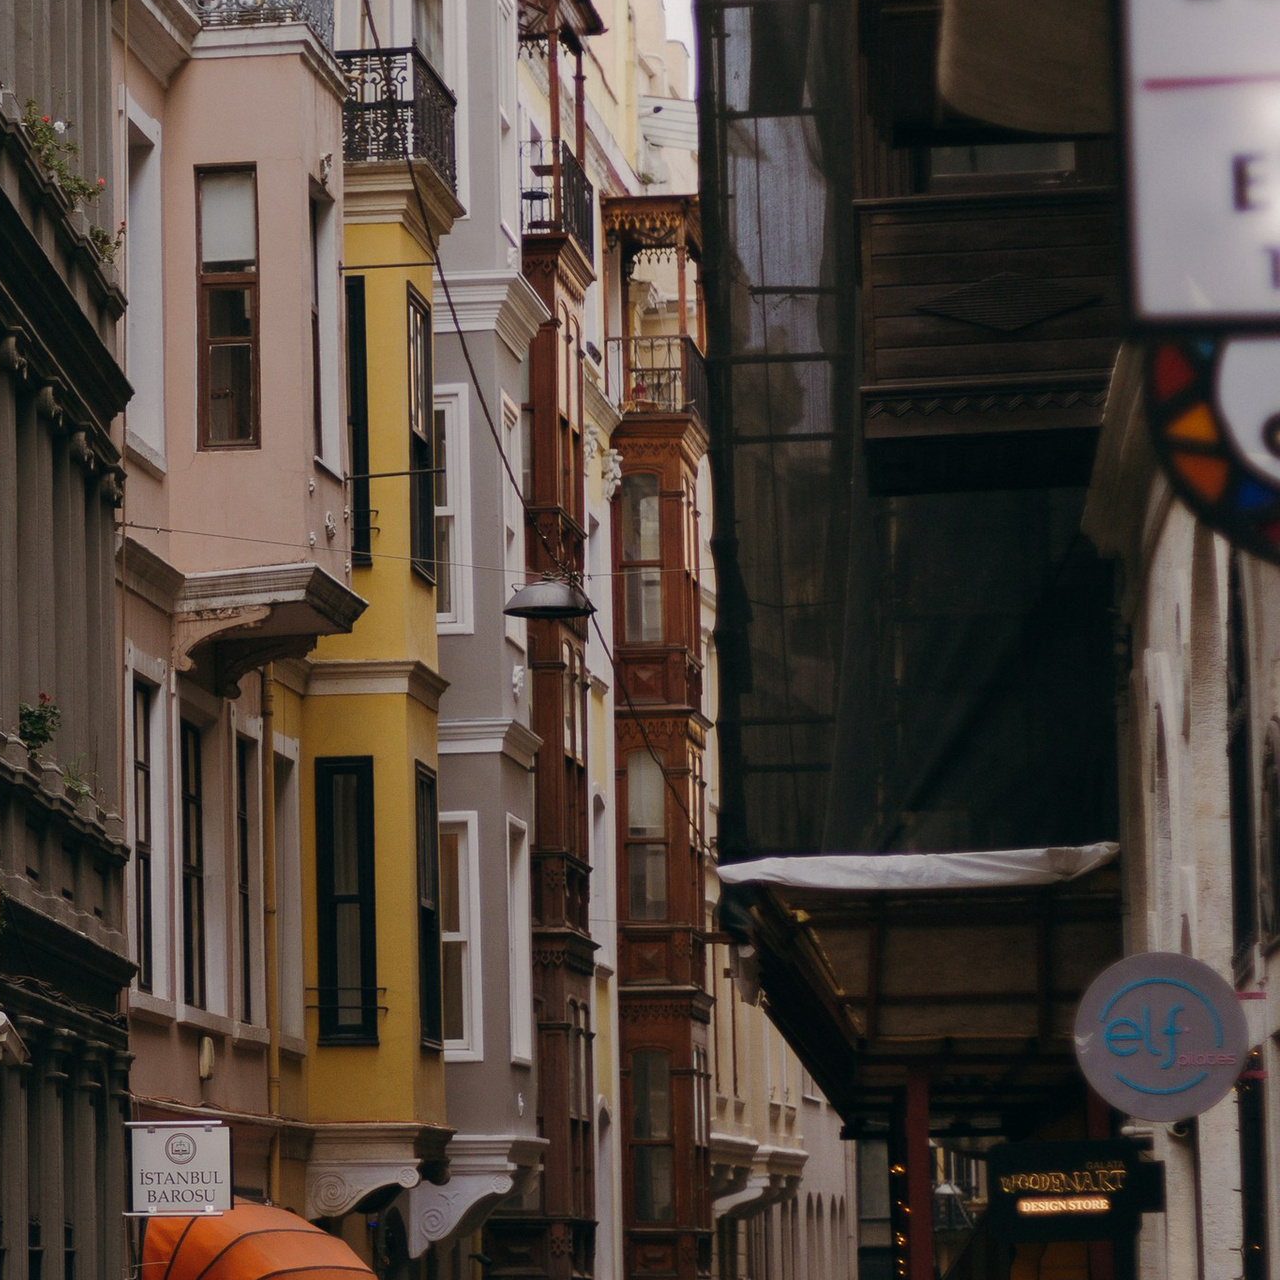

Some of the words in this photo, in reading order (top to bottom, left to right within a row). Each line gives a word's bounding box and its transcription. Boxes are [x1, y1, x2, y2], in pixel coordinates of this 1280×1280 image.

[1104, 1003, 1185, 1070] elf
[139, 1168, 224, 1186] İSTANBUL
[147, 1188, 216, 1204] BAROSU
[1022, 1199, 1067, 1212] DESIGN
[1068, 1198, 1110, 1211] STORE
